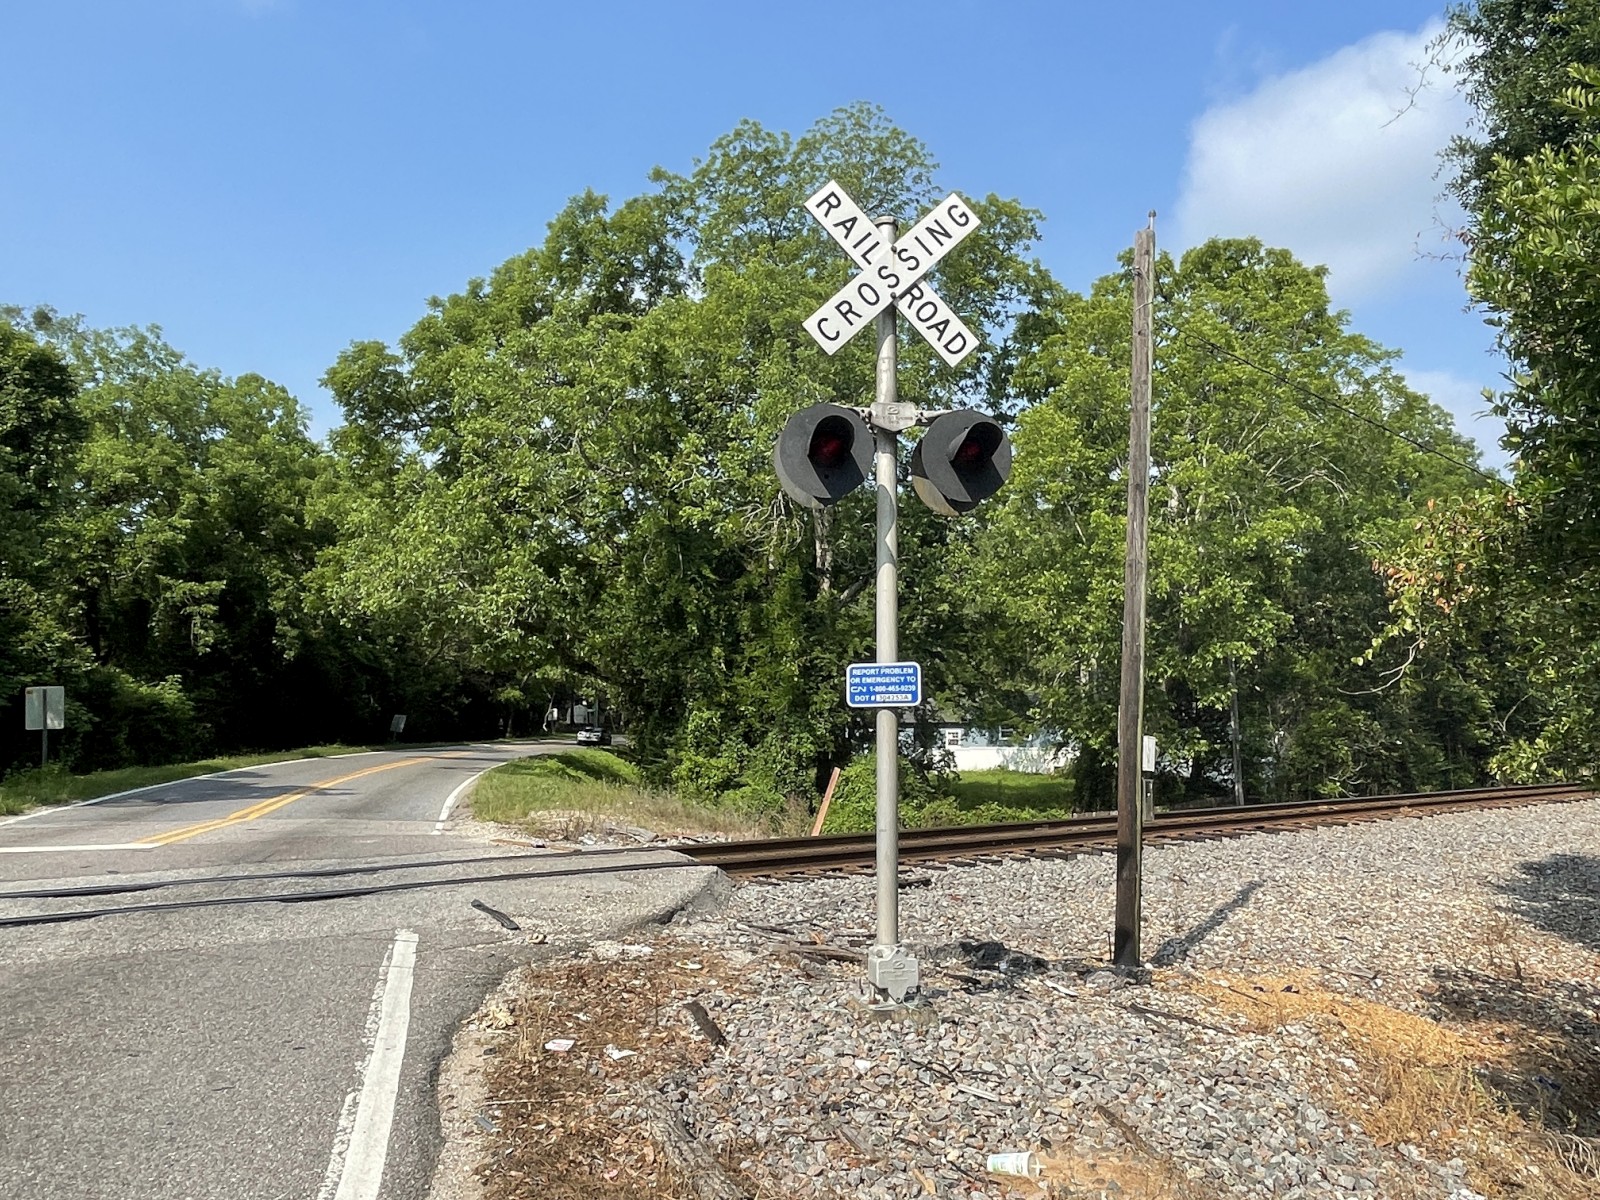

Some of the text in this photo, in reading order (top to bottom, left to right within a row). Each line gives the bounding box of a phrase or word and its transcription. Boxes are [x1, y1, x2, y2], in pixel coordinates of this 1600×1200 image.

[816, 191, 967, 355] RAIL ROAD
[817, 204, 970, 342] CROSSING
